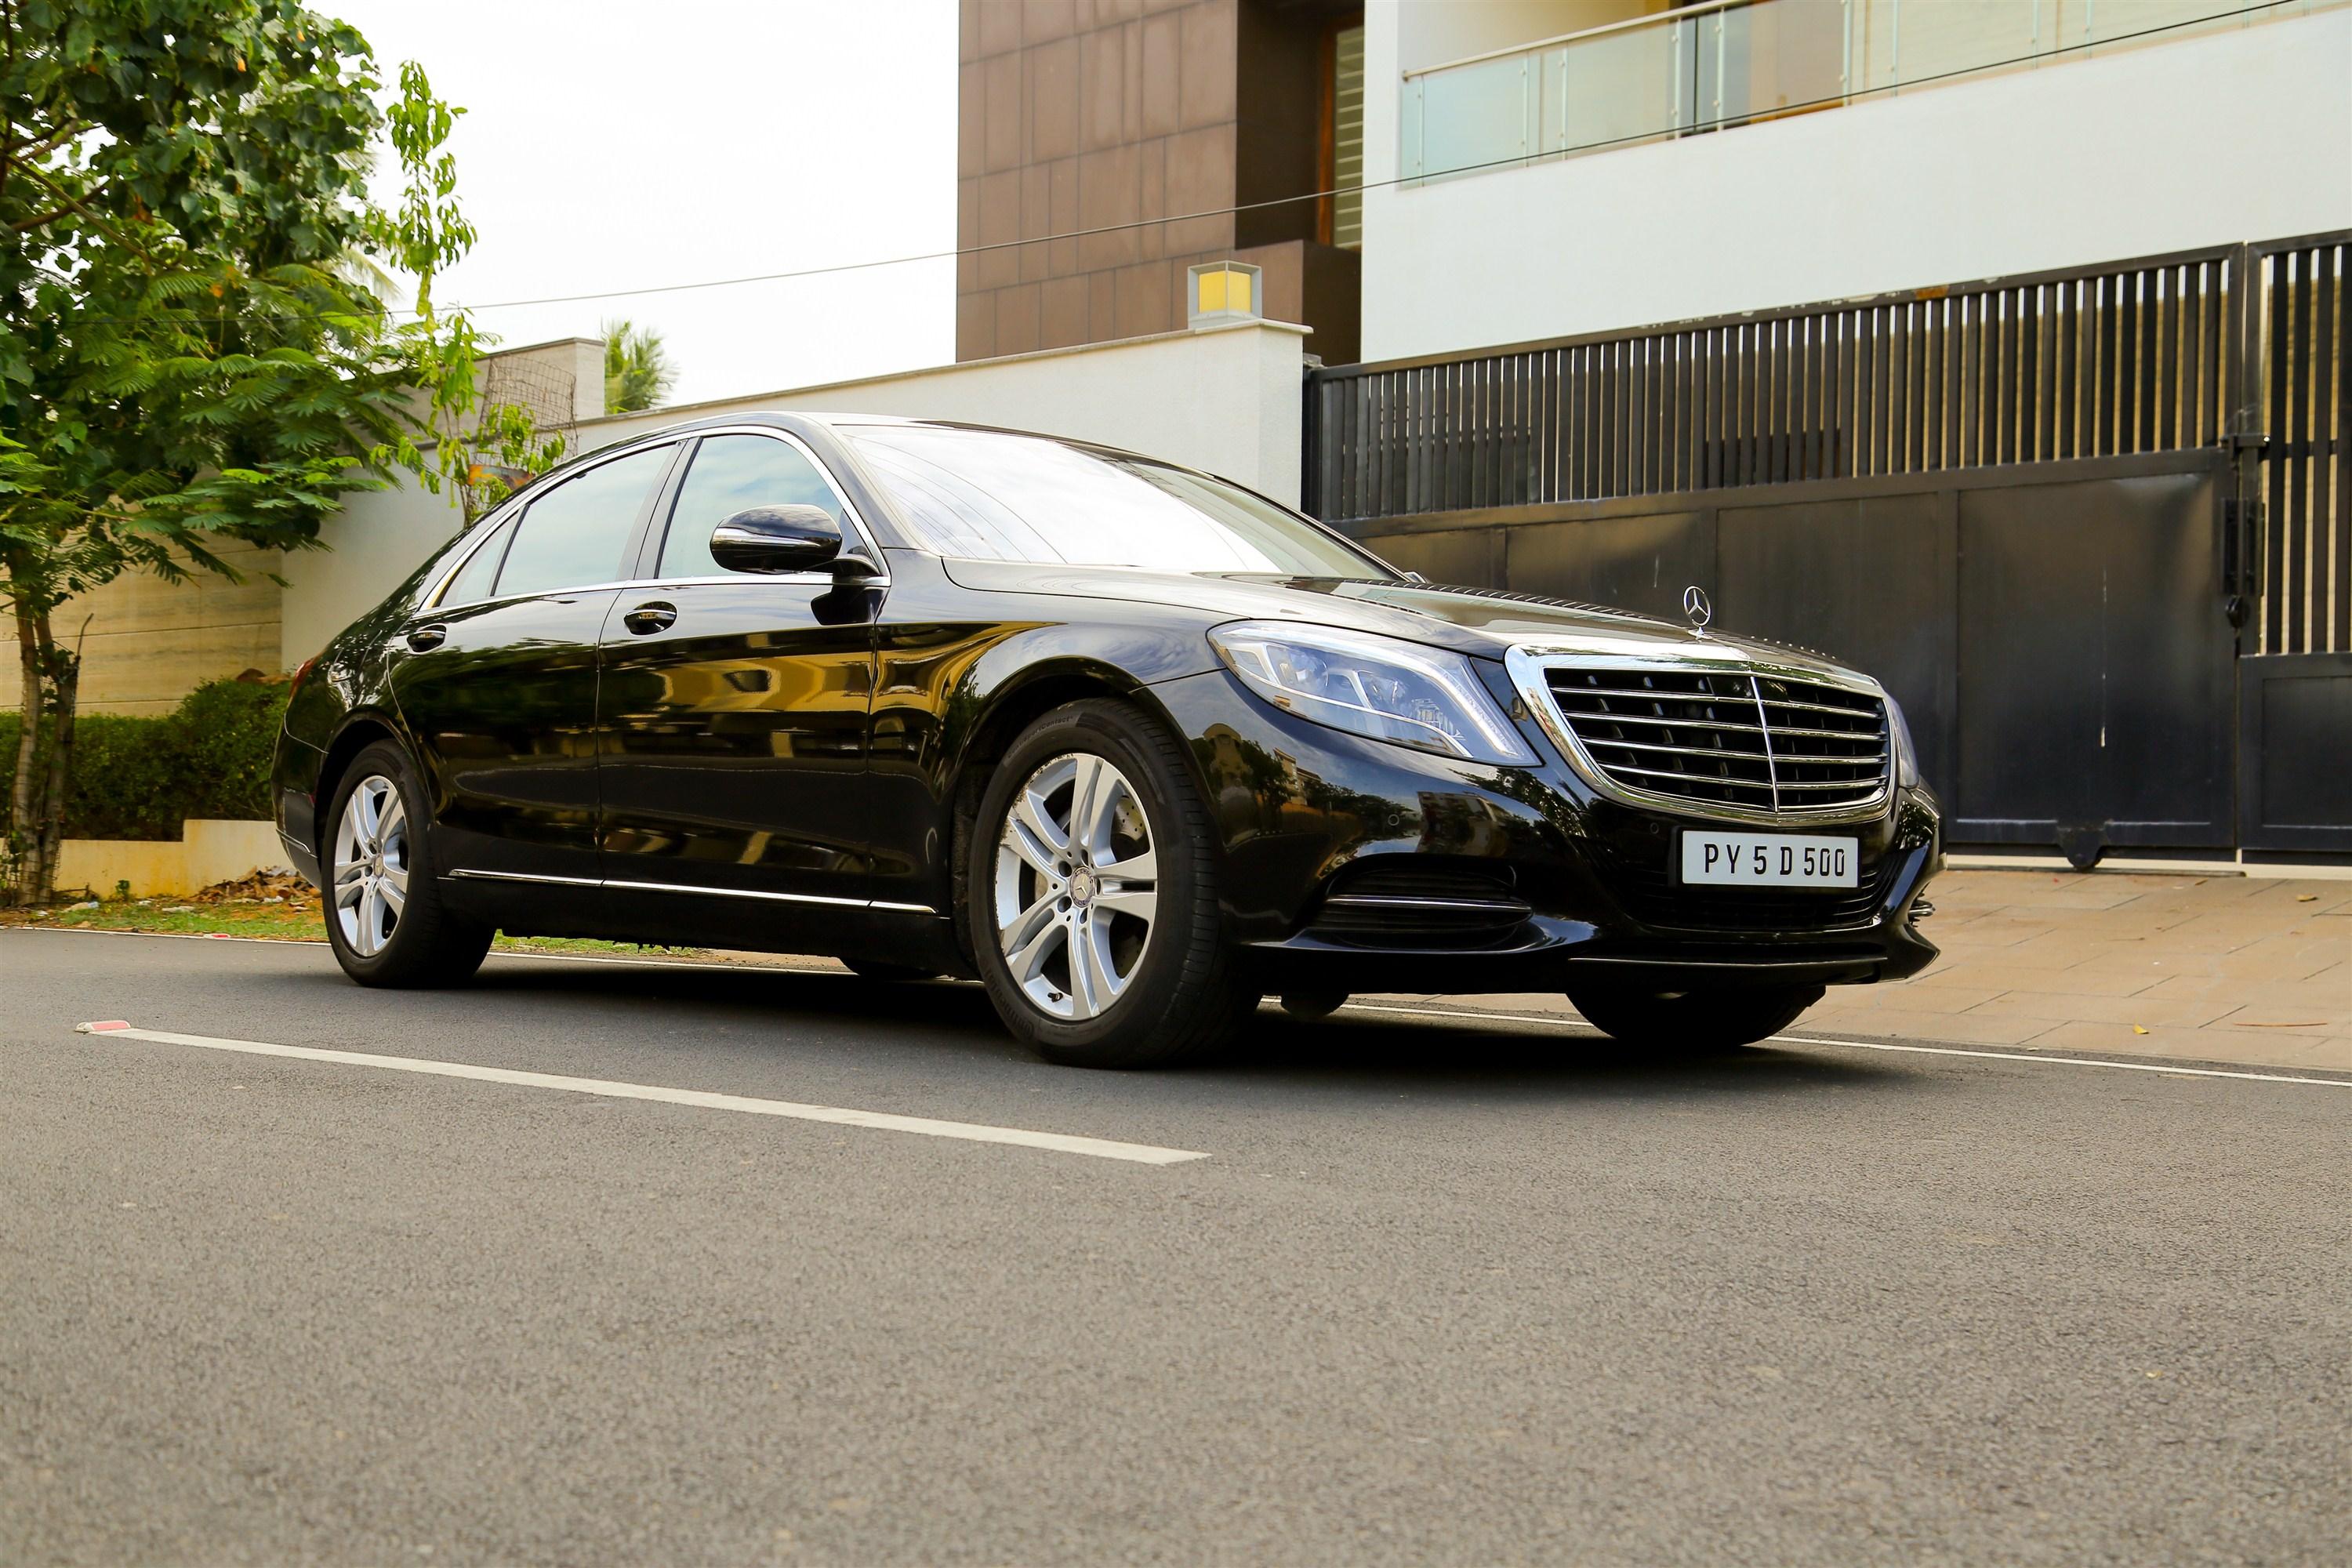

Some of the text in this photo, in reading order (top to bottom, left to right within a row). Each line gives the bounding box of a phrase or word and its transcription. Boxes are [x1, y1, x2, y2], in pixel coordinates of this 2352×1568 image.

[1704, 844, 1845, 877] PY 5 D 500
